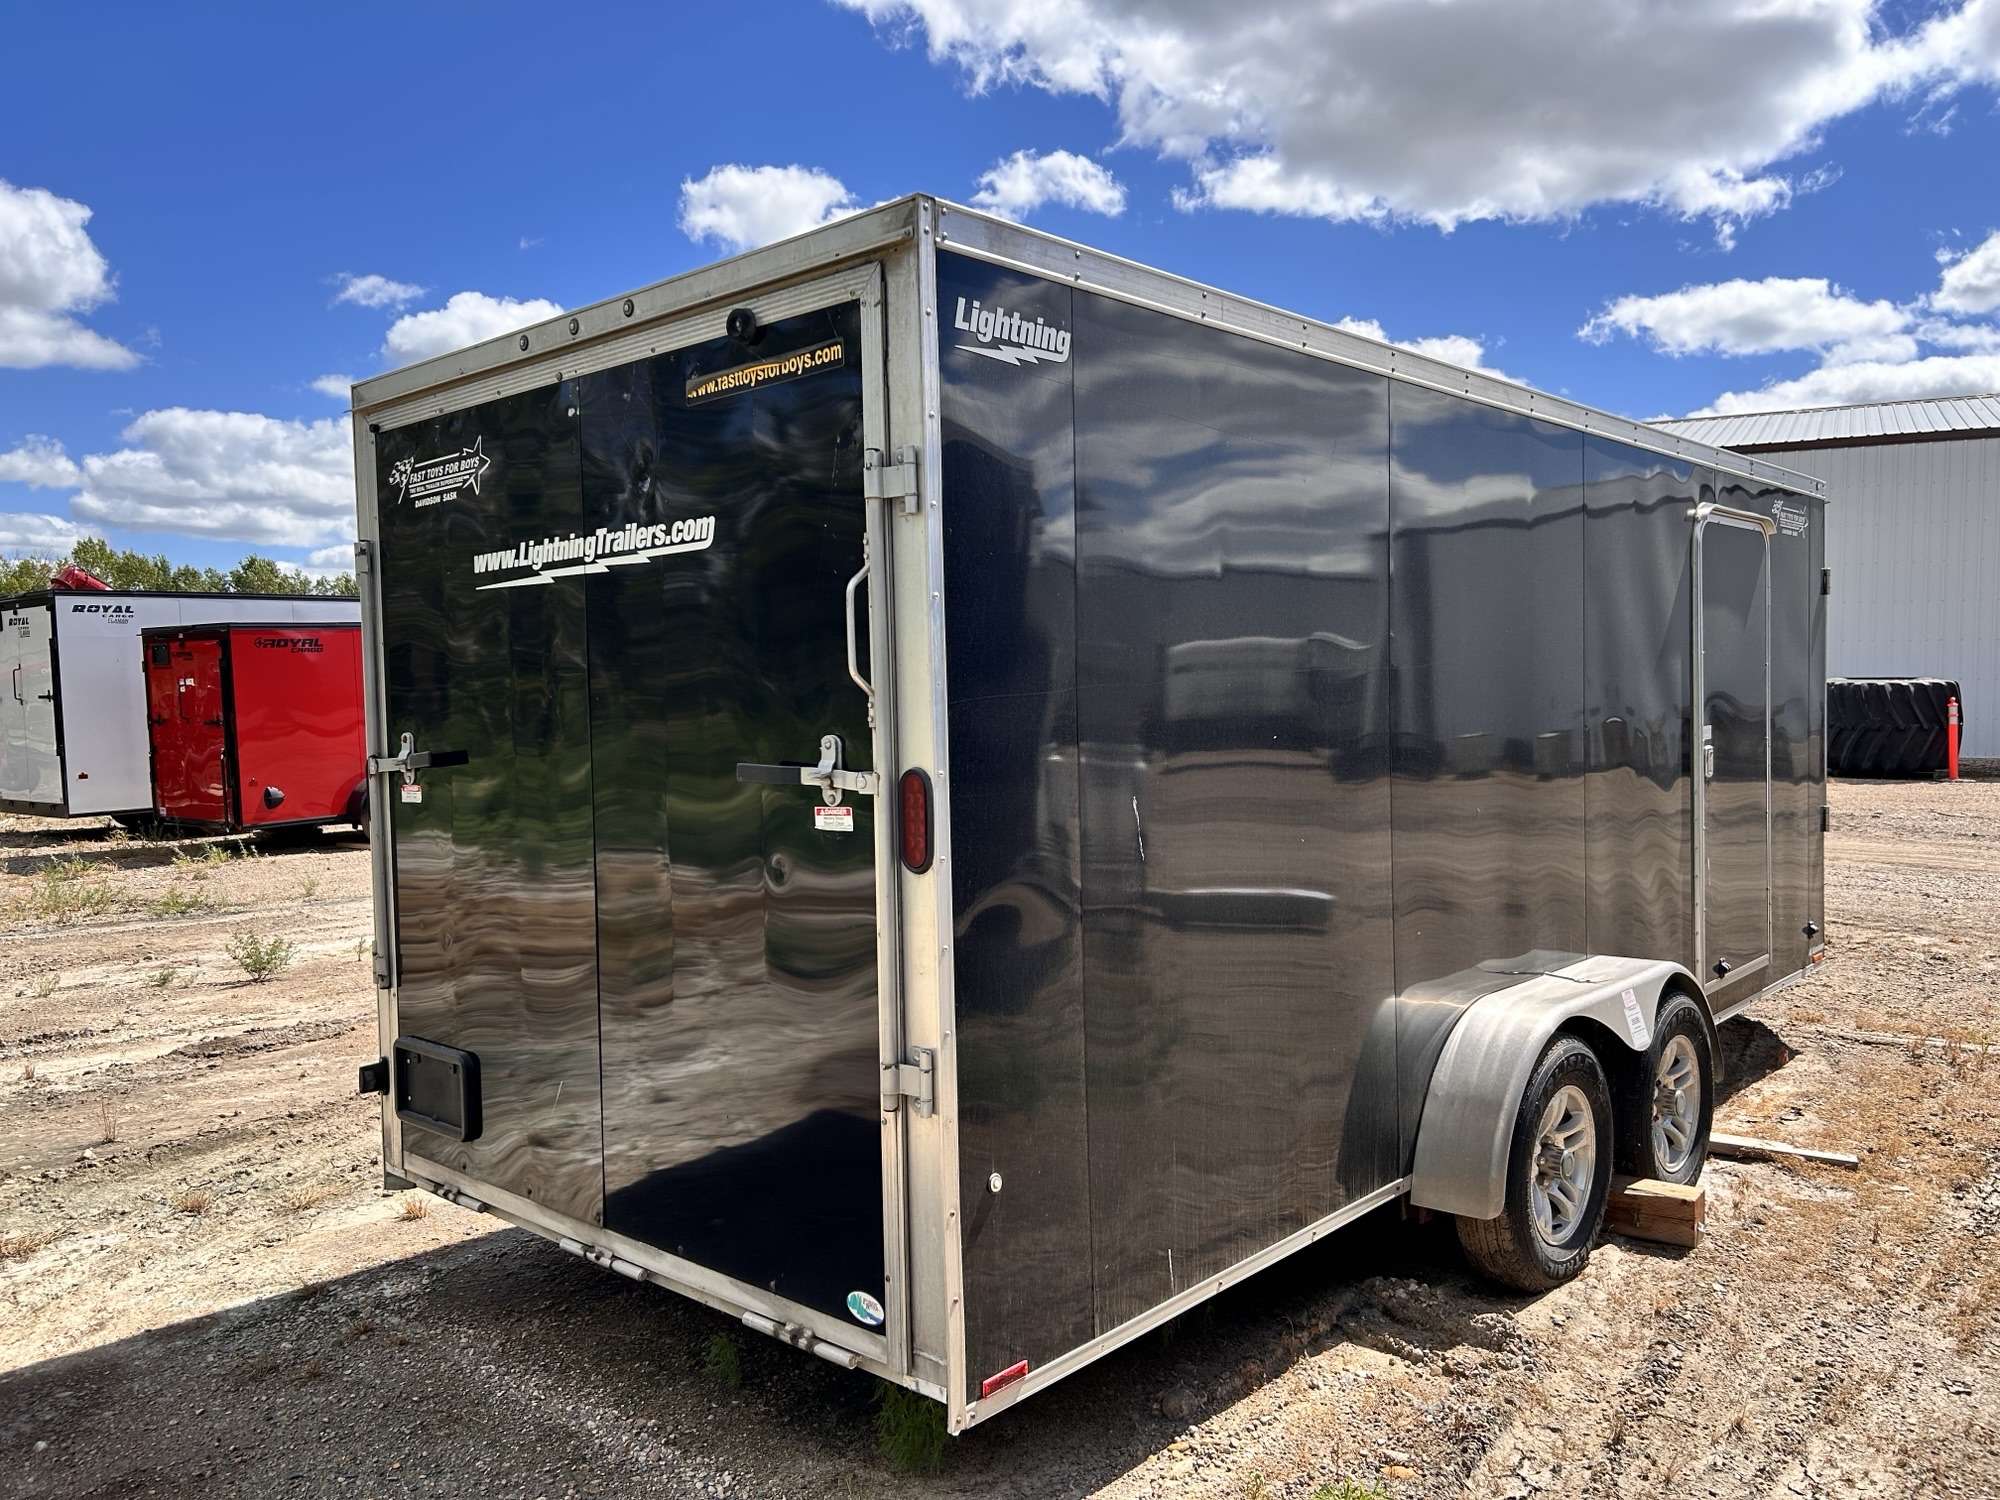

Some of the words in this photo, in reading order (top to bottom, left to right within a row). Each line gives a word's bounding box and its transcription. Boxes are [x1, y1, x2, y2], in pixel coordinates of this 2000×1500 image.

[954, 297, 1072, 360] Lightning
[409, 471, 425, 484] FAST
[427, 466, 444, 480] TOYS
[445, 462, 459, 476] FOR
[460, 456, 480, 471] BOYS
[415, 495, 441, 508] DAVIDSON
[443, 491, 457, 502] SASK
[473, 515, 716, 574] www.LightningTrailers.com
[71, 604, 134, 614] ROYAL
[8, 617, 30, 626] ROYAL
[262, 638, 324, 649] ROYAL
